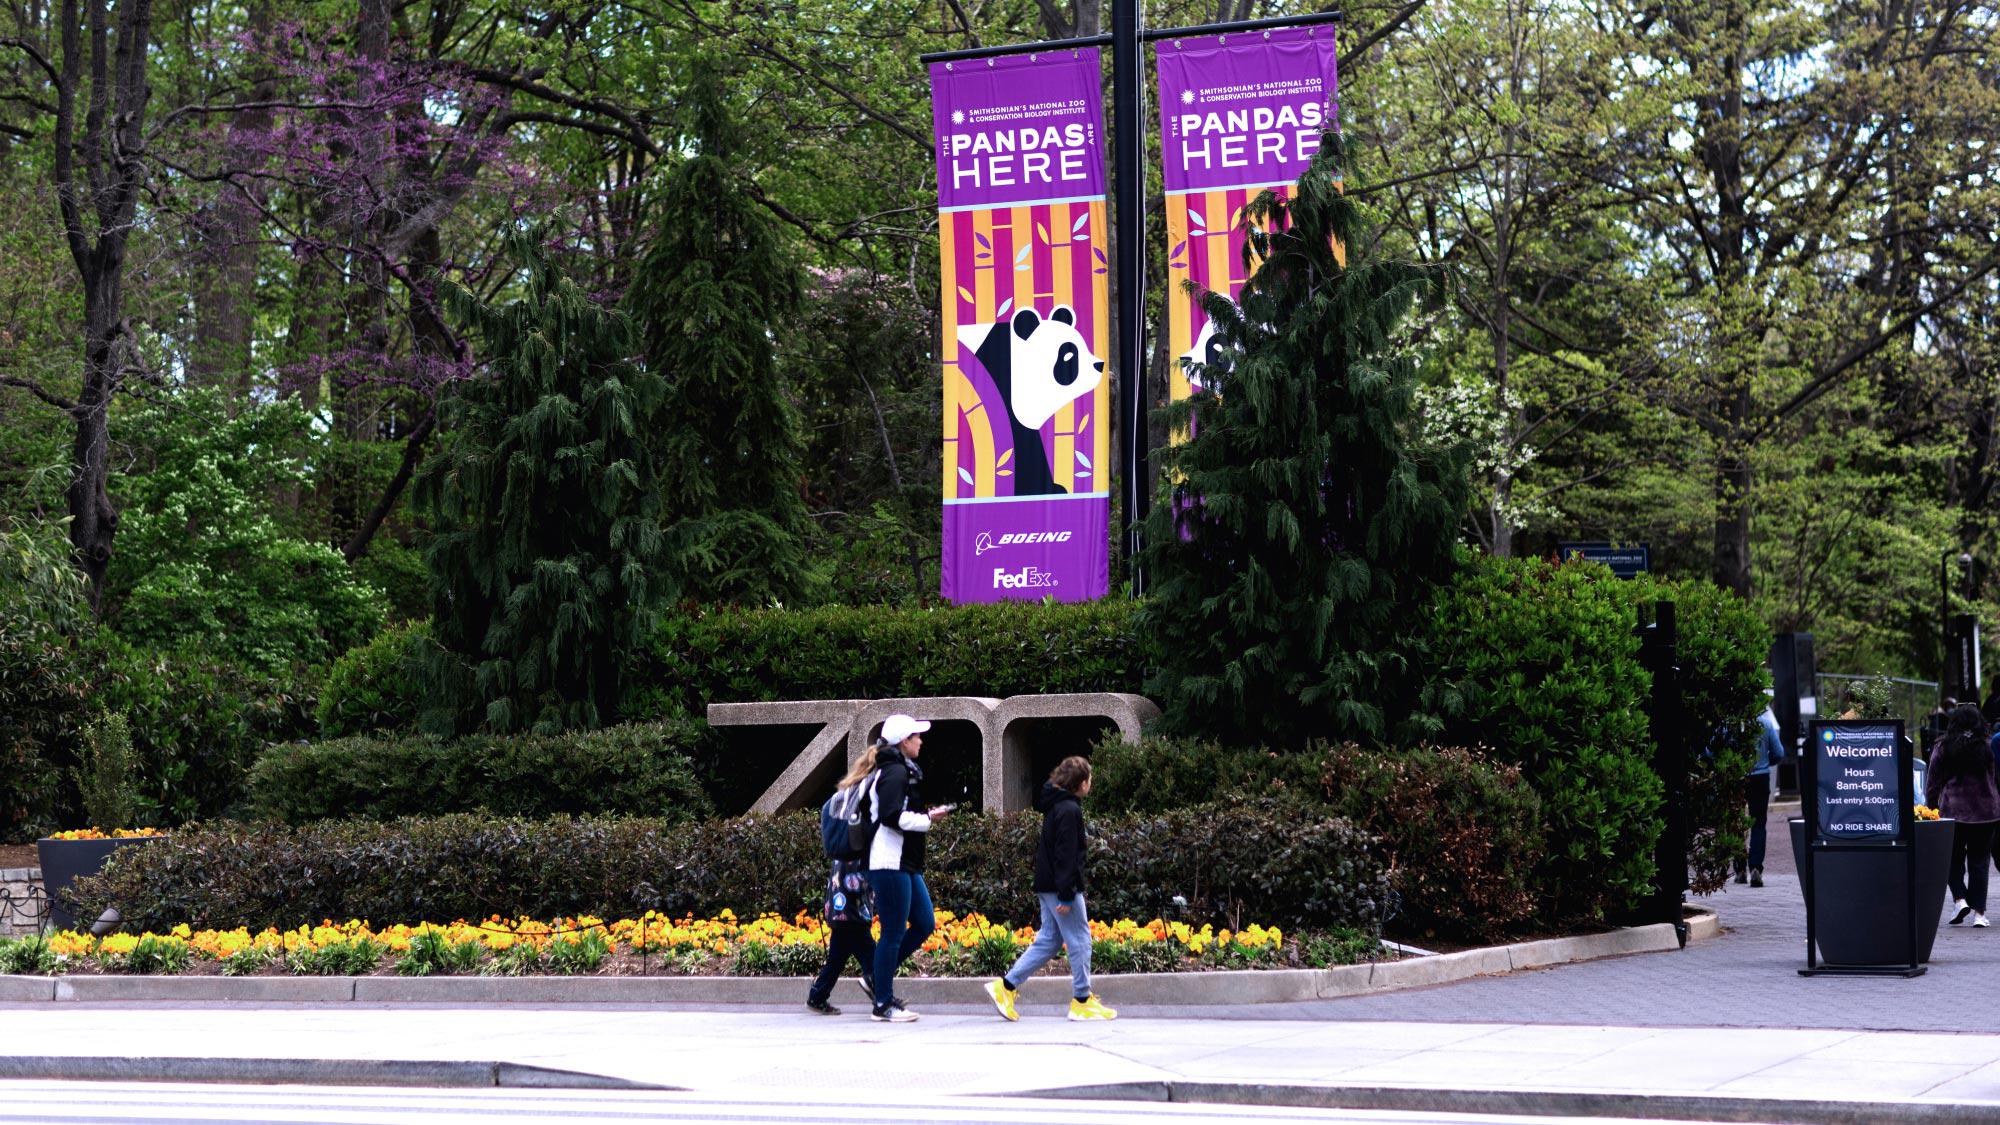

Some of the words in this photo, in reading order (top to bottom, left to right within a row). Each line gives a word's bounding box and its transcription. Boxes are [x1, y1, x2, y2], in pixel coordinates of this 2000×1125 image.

[1200, 84, 1261, 96] SMITHSONIAN'S
[1264, 79, 1302, 90] NATIONAL
[1305, 77, 1322, 86] ZOO
[1207, 92, 1257, 102] CONSERVATION
[1259, 89, 1287, 98] BIOLOGY
[1288, 85, 1322, 95] INSTITUTE
[969, 105, 1026, 115] SMITHSONIAN'S
[1029, 101, 1066, 110] NATIONAL
[1069, 99, 1086, 107] ZOO
[976, 113, 1023, 123] CONSERVATION
[1024, 110, 1052, 119] BIOLOGY
[1052, 107, 1086, 116] INSTITUTE
[1181, 102, 1322, 138] PANDAS
[951, 123, 1086, 157] PANDAS
[1087, 123, 1095, 145] ARE
[1182, 129, 1320, 170] HERE
[952, 149, 1087, 190] HERE
[998, 532, 1072, 544] BOEING
[1826, 745, 1892, 757] Welcome!
[1844, 768, 1874, 777] Hours
[1836, 781, 1884, 791] 8am-6pm
[1864, 797, 1894, 805] 5:00pm
[1830, 823, 1844, 831] NO
[1845, 823, 1863, 831] RIDE
[1865, 823, 1892, 831] SHARE
